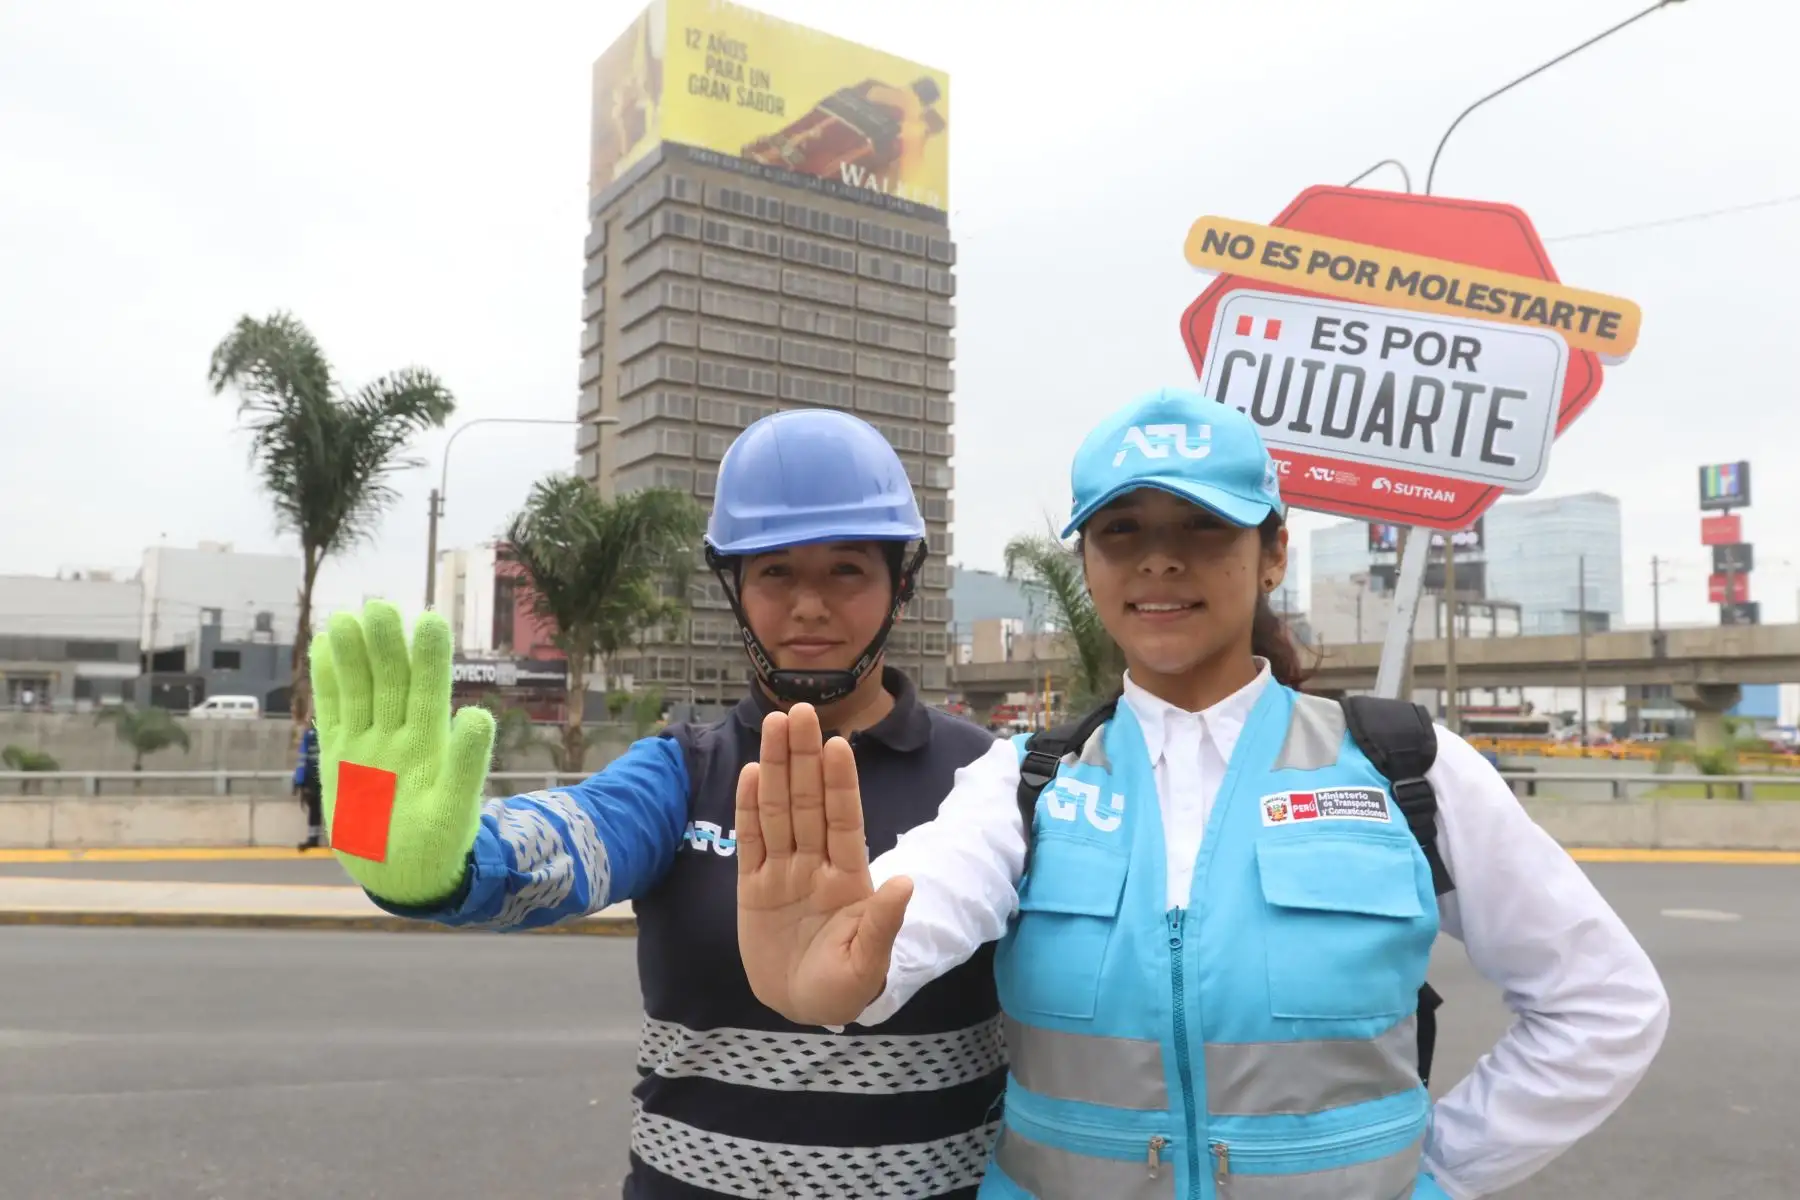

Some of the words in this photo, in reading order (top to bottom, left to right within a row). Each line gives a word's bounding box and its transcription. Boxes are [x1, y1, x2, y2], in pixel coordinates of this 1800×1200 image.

[685, 28, 702, 49] 12
[705, 55, 744, 83] PARA
[749, 67, 771, 89] UN
[688, 73, 731, 102] GRAN
[736, 86, 786, 117] SABOR
[1201, 229, 1255, 260] NO
[1260, 242, 1302, 270] ES
[1307, 250, 1381, 288] POR
[1385, 266, 1622, 341] MOLESTARTE
[1310, 316, 1369, 356] ES
[1379, 326, 1482, 373] POR
[1214, 349, 1529, 467] CUIDARTE
[1112, 423, 1212, 468] ATU
[1271, 459, 1292, 475] TC
[1393, 480, 1456, 504] SUTRAN
[454, 663, 496, 682] OYECTO
[1292, 799, 1316, 813] PERÚ
[1318, 791, 1369, 801] Ministerio
[1323, 800, 1333, 808] de
[1335, 799, 1380, 811] Transportes
[1329, 807, 1387, 819] Comunicaciones
